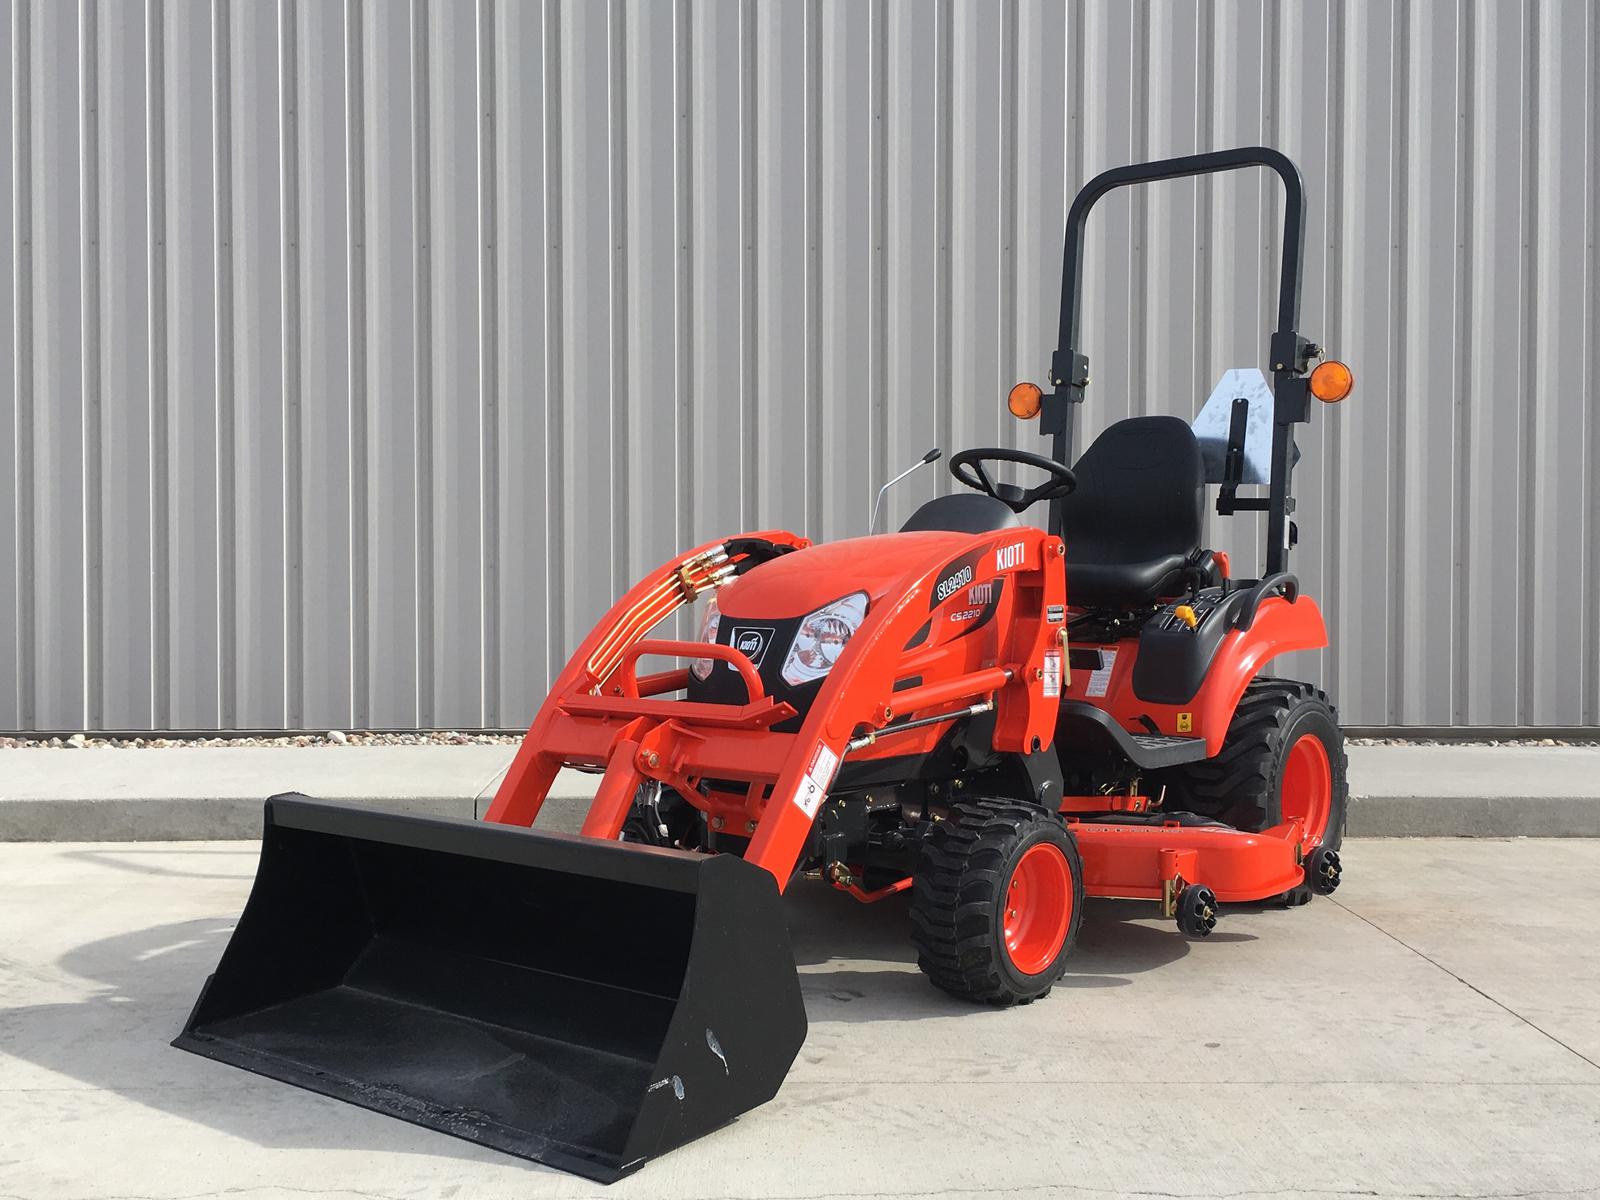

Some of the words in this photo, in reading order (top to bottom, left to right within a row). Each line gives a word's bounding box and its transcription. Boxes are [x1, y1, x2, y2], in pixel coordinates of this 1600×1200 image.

[996, 542, 1025, 571] KIOTI
[968, 583, 992, 605] KIOTI
[950, 609, 981, 622] CS2210
